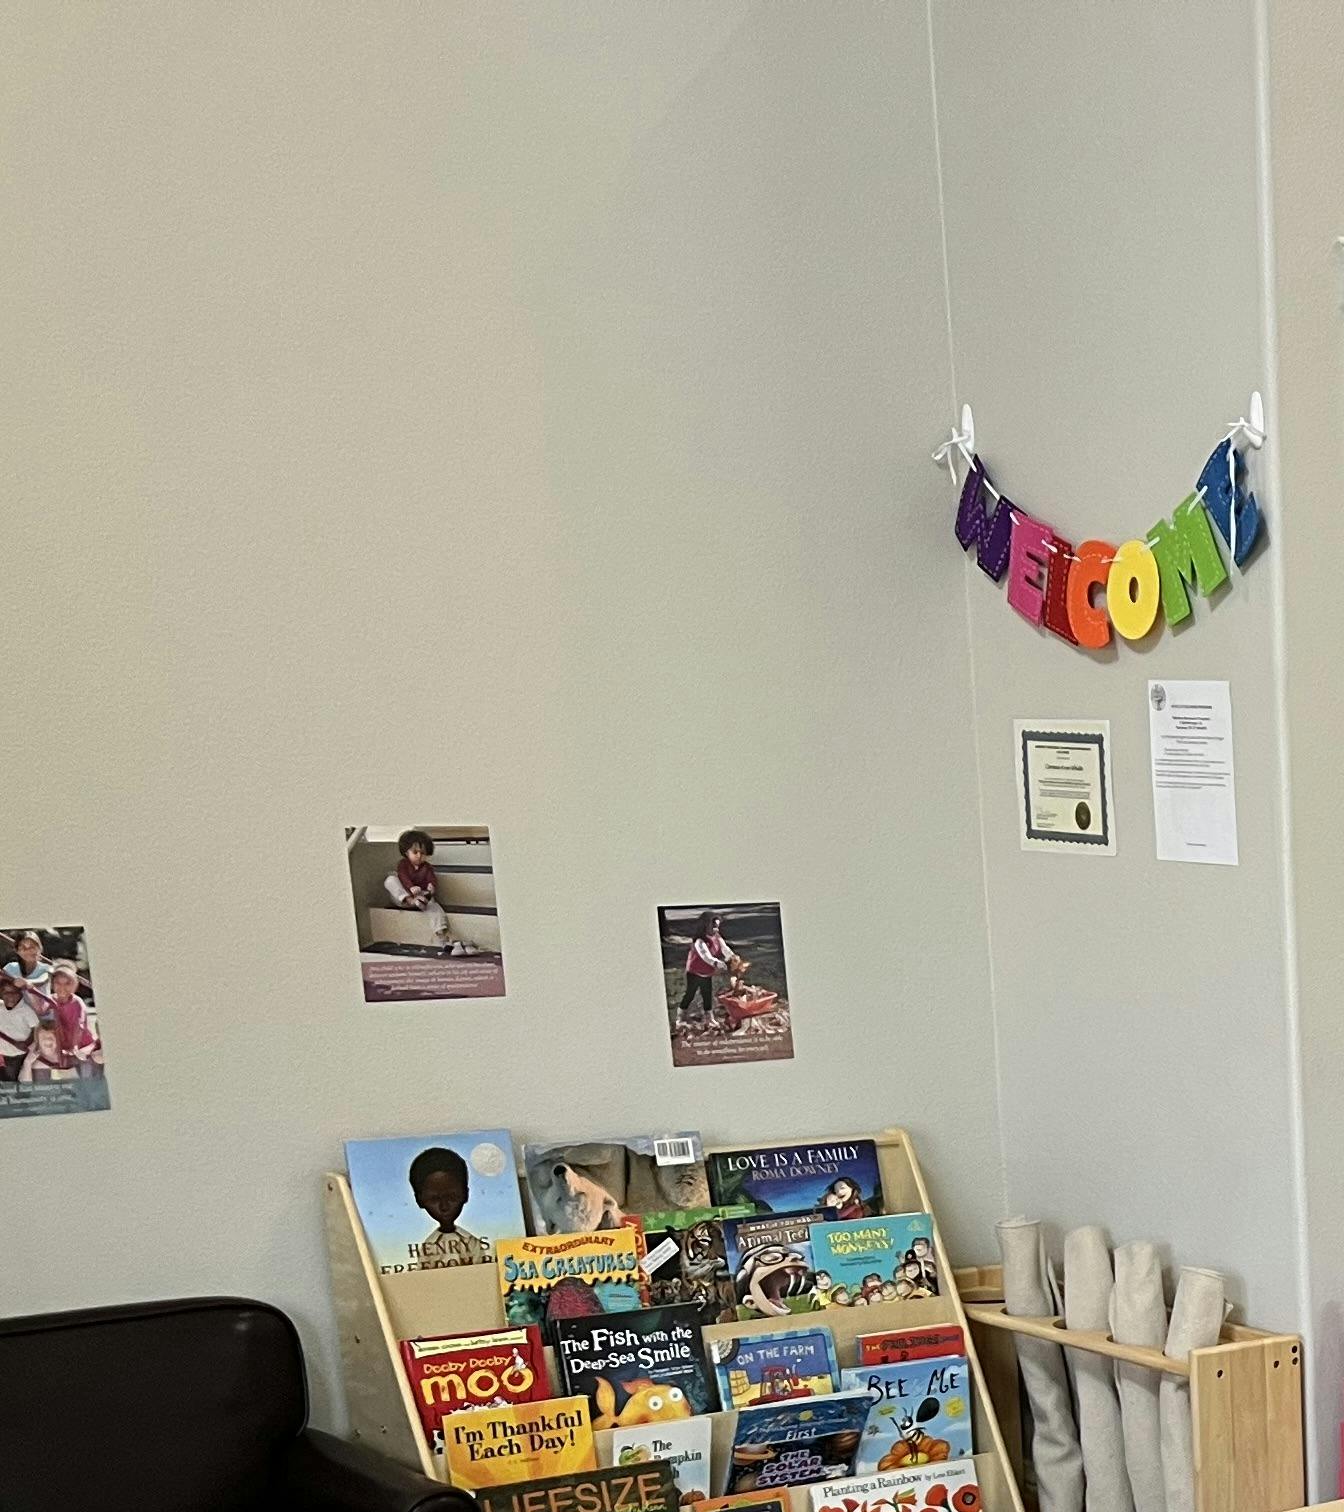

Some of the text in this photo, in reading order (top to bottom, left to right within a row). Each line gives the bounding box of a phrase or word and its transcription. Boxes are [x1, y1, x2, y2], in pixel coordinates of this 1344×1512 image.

[955, 437, 1260, 648] WELCOME
[727, 1145, 859, 1172] LOVE IS A FAMILY
[751, 1162, 840, 1181] ROMA DOWNEY
[521, 1236, 616, 1256] EXTRAORDINARY
[827, 1228, 889, 1244] TOO MANY
[541, 1251, 637, 1280] CREATURES
[560, 1326, 693, 1355] The Fish with the
[570, 1352, 636, 1374] Deep-Sea
[637, 1342, 691, 1370] Smile
[736, 1344, 815, 1365] ON THE FARM
[867, 1374, 910, 1407] BEE
[926, 1367, 960, 1396] ME
[454, 1409, 583, 1445] I'm Thankful
[468, 1428, 576, 1462] Each Day!
[651, 1439, 673, 1453] The
[780, 1449, 810, 1462] THE
[755, 1466, 823, 1488] SYSTEM
[761, 1455, 823, 1475] SOLAR
[822, 1482, 870, 1498] Planting
[870, 1481, 877, 1490] a
[876, 1473, 923, 1489] Rainbow
